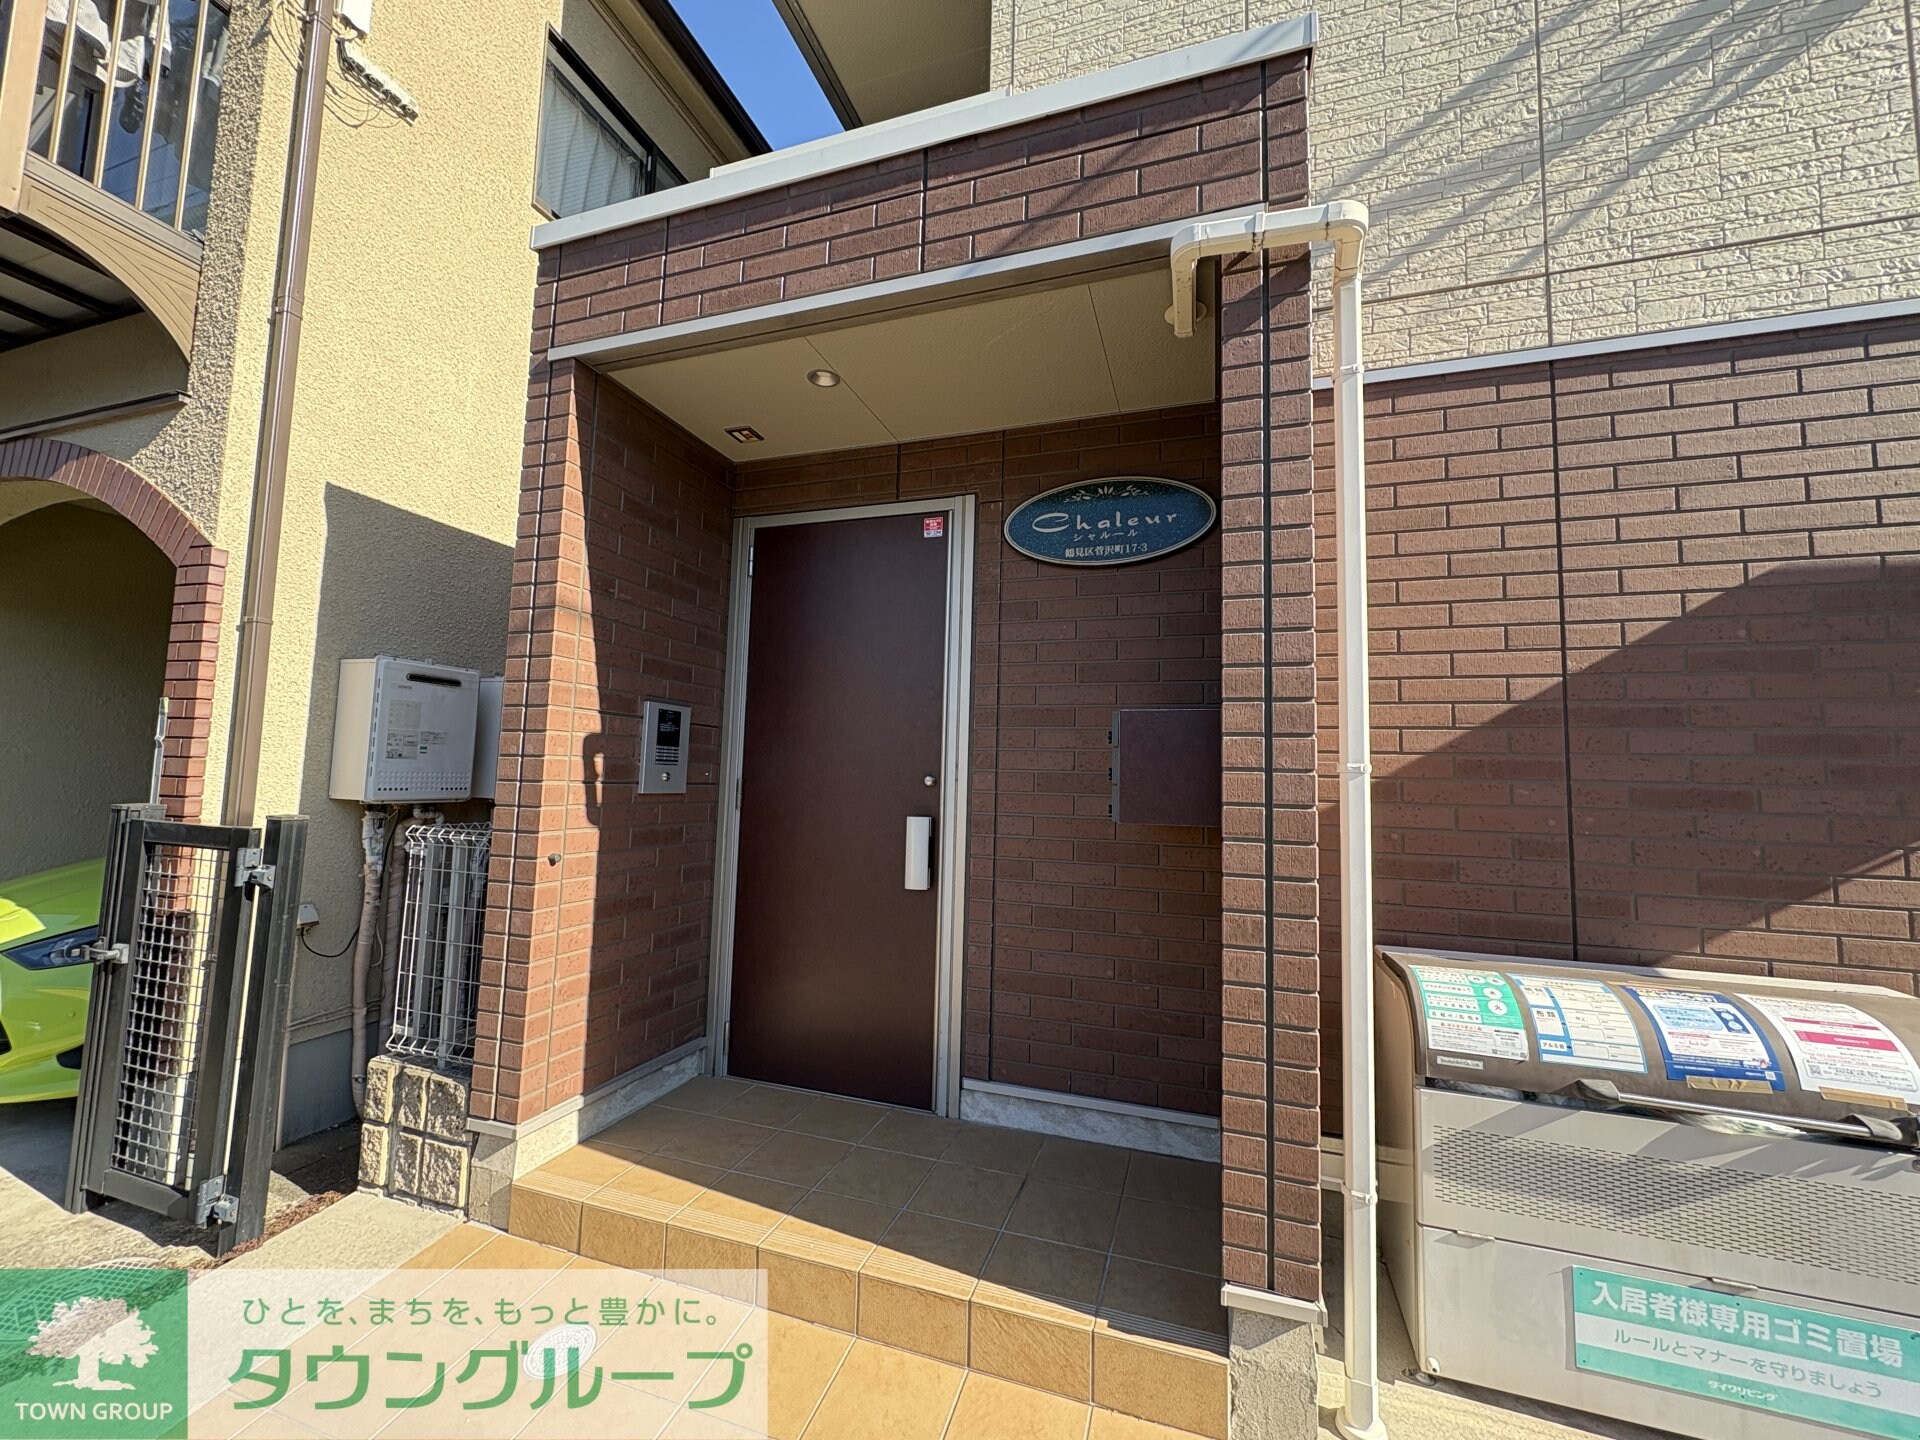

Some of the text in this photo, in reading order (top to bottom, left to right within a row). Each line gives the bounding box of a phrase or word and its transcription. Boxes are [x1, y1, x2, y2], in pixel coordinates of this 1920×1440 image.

[1032, 511, 1178, 533] Chaleur
[1073, 529, 1139, 542] シャルール
[1592, 1280, 1903, 1368] 入居者様専用ゴミ置場
[1614, 1328, 1882, 1399] ルールとマナーを守りましょう
[1707, 1379, 1777, 1401] ダイワリビング
